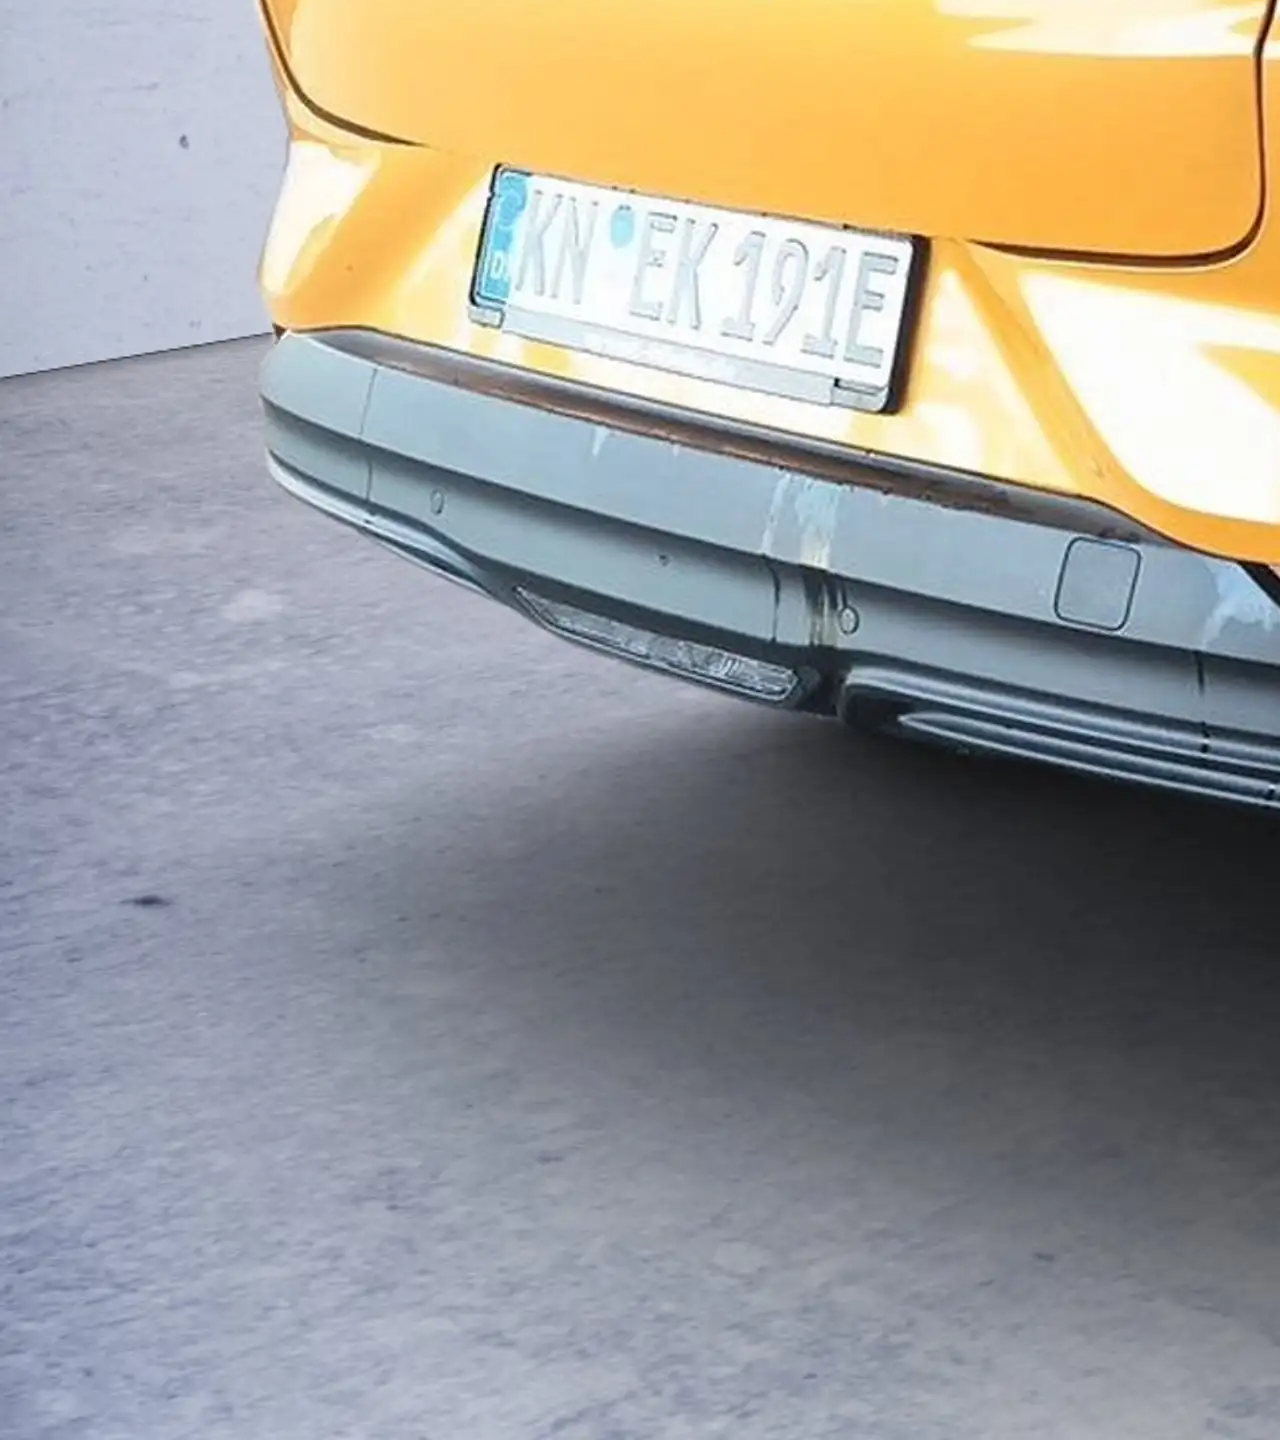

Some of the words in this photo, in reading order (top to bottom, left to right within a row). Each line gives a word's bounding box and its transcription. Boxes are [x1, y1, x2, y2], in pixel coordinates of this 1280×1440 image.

[514, 188, 600, 305] KN
[628, 210, 719, 331] EK
[719, 228, 901, 368] 191E
